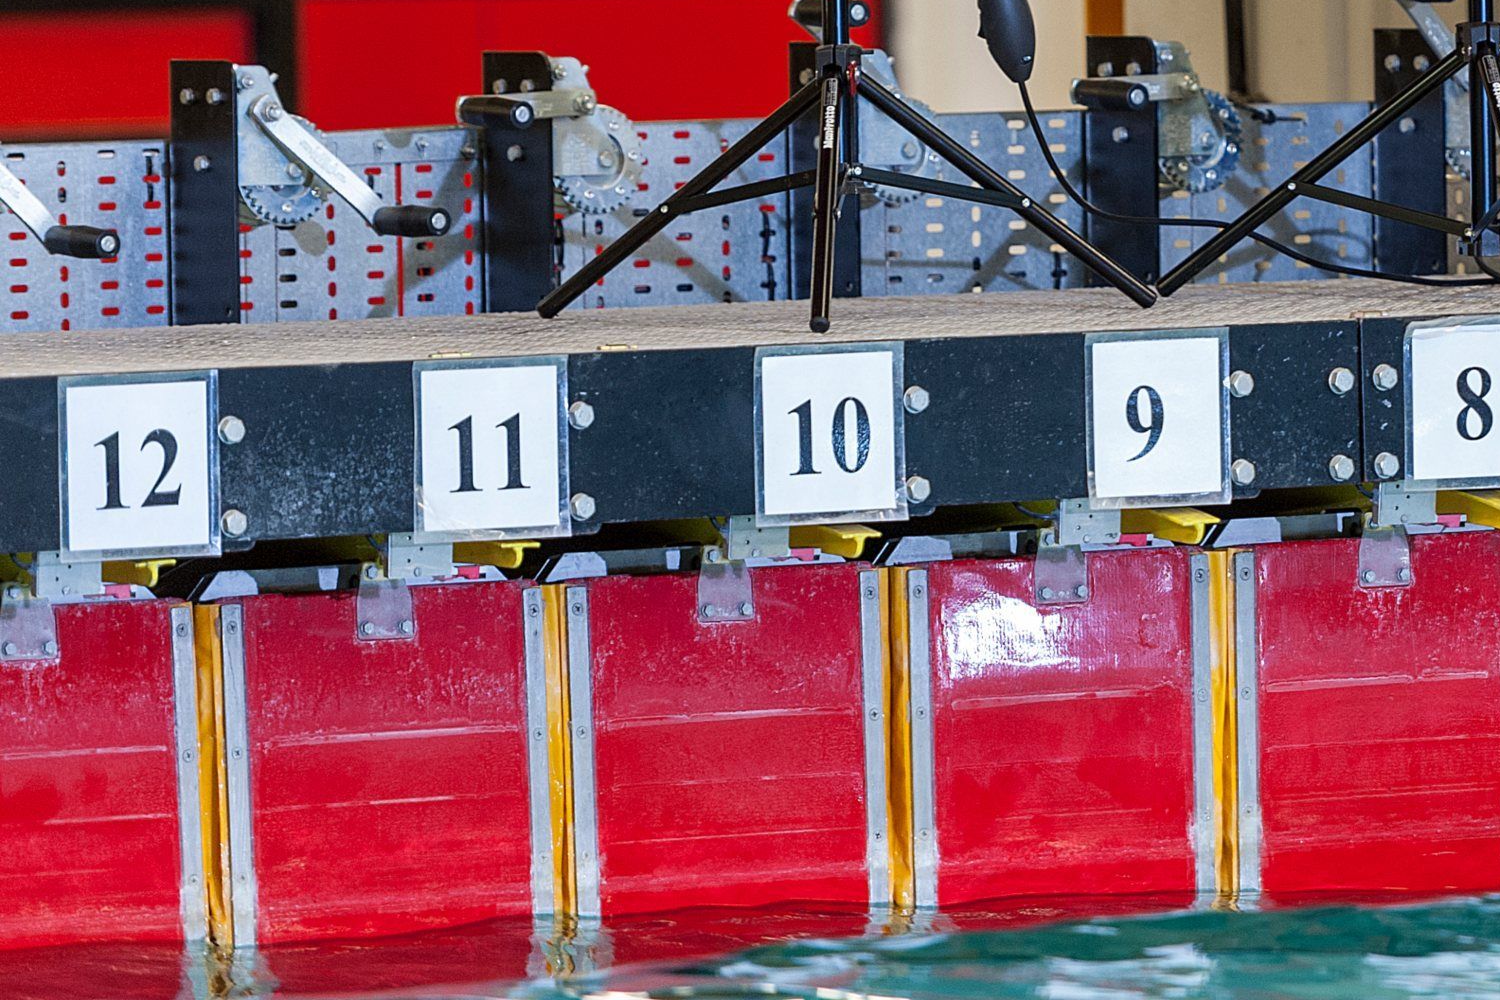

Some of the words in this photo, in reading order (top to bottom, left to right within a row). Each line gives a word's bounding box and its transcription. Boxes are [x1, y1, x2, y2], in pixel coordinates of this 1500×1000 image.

[823, 105, 836, 149] Manfrotto
[787, 396, 871, 476] 10
[1125, 385, 1164, 462] 9
[1456, 366, 1494, 441] 8
[94, 429, 182, 510] 12
[447, 412, 531, 493] 11
